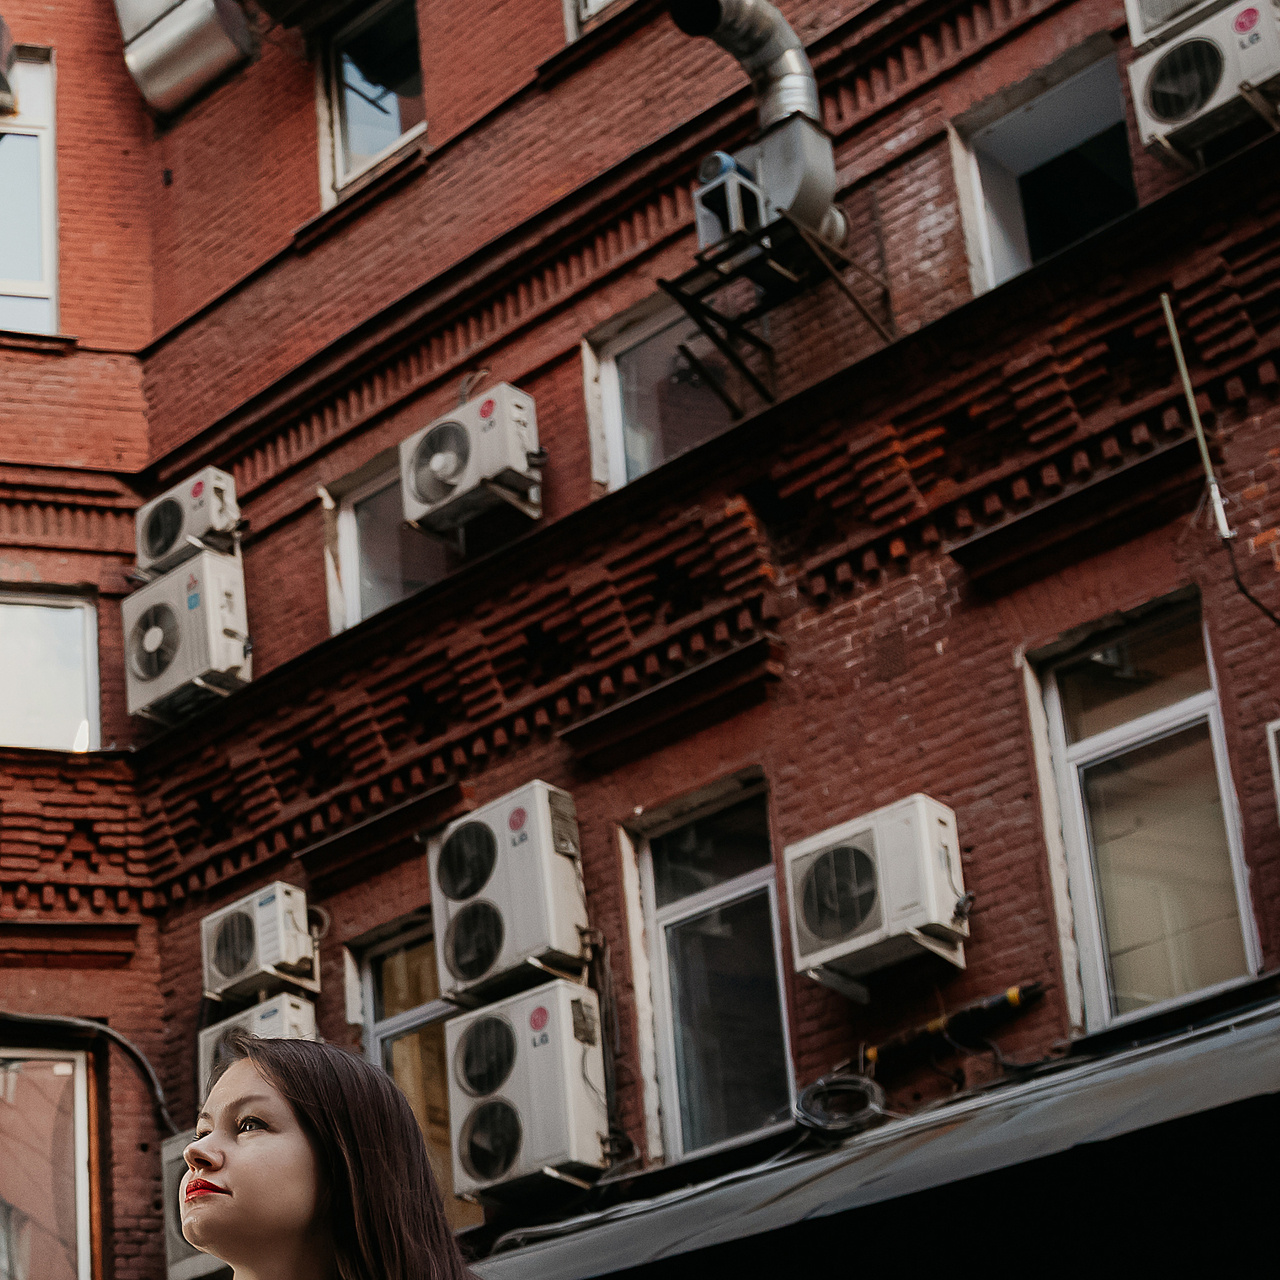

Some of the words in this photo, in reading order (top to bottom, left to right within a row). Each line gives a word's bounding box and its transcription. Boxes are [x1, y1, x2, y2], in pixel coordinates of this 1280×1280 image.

[1238, 32, 1261, 50] LG
[510, 832, 528, 847] LG
[531, 1033, 549, 1048] LG
